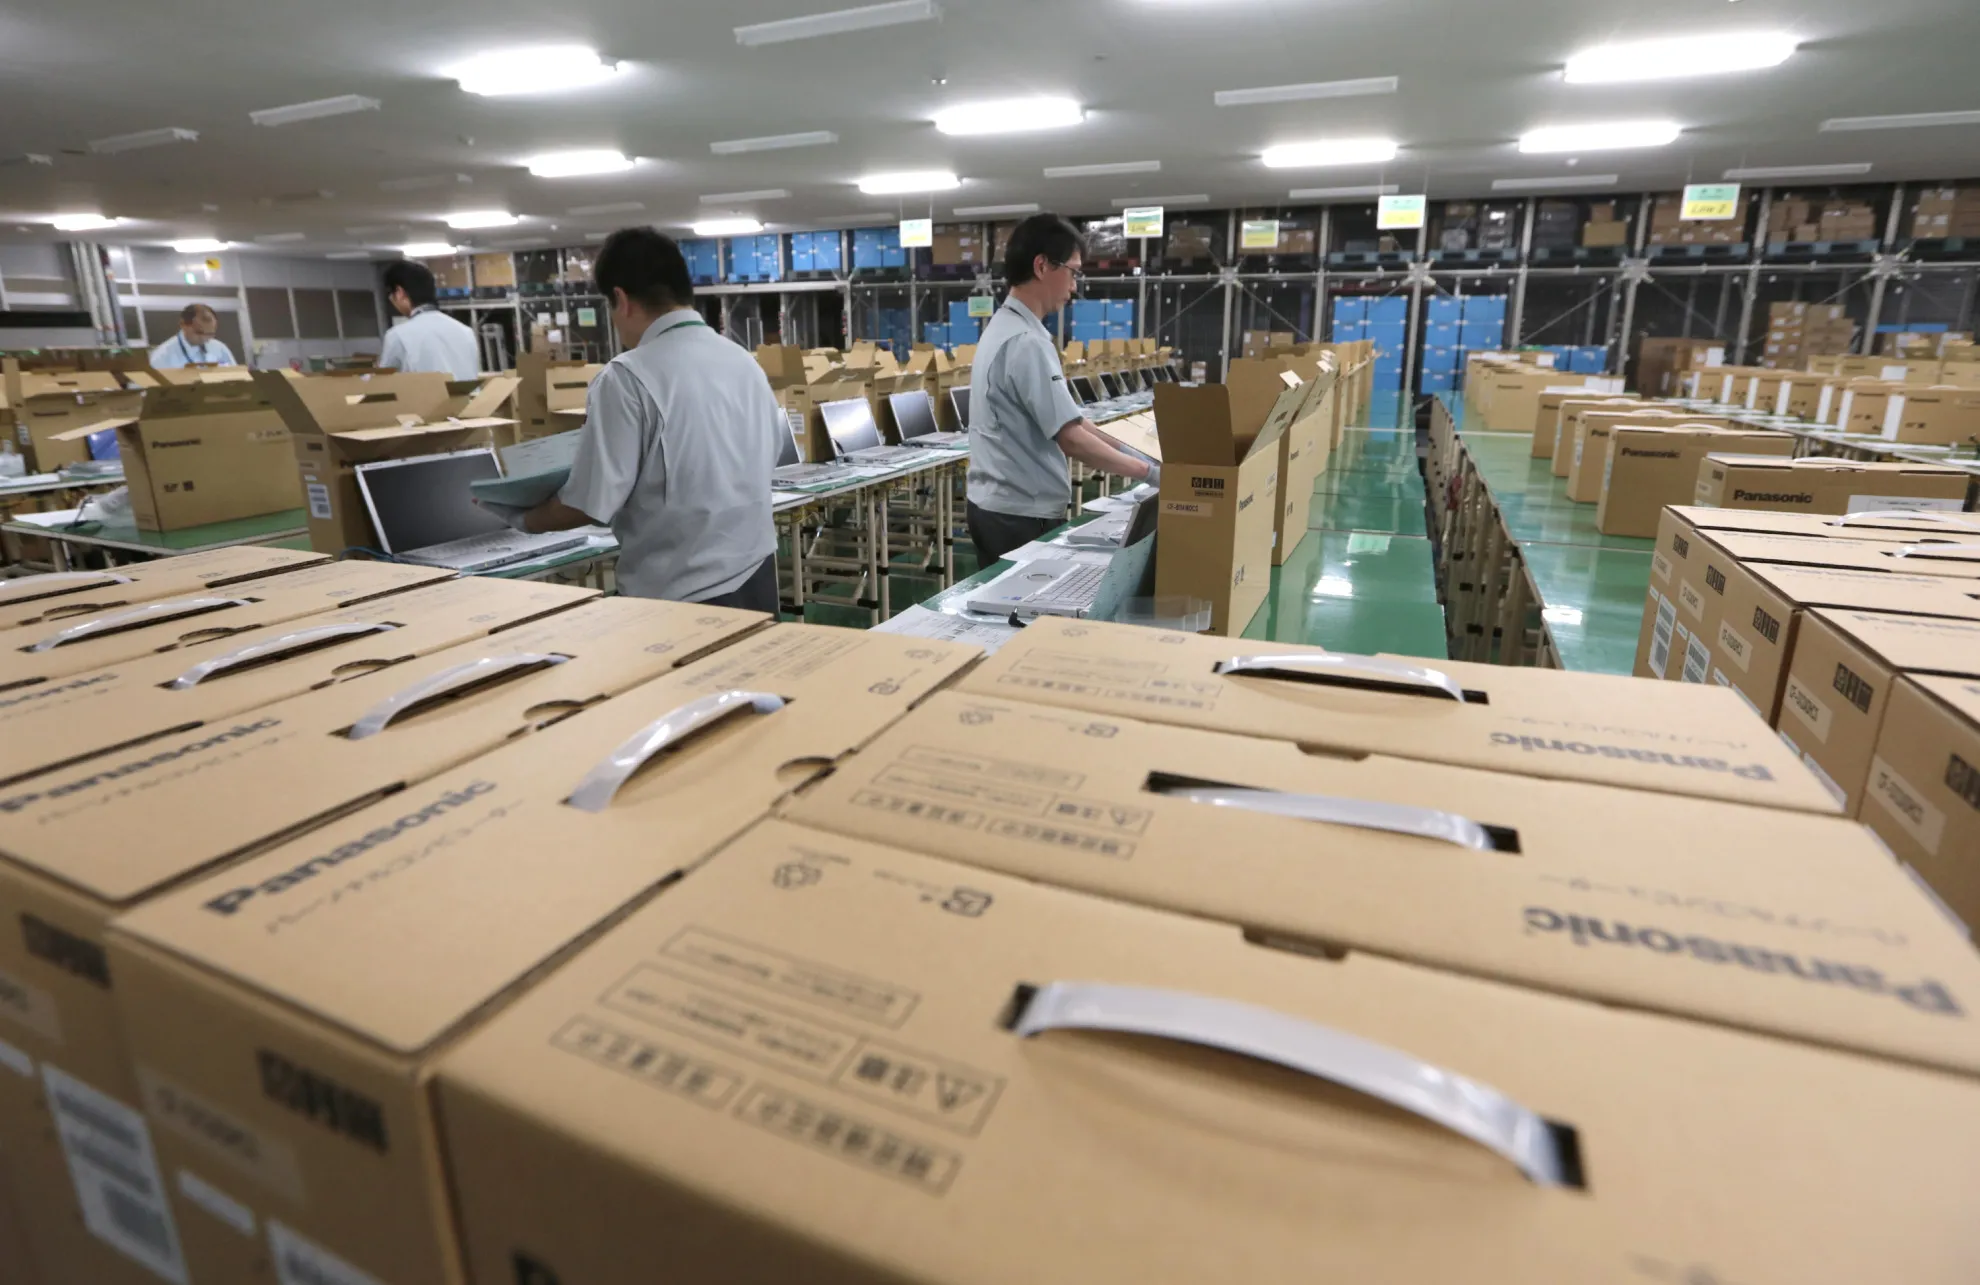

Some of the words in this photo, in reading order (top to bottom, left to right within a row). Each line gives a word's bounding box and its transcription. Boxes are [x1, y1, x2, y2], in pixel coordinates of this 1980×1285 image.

[1622, 447, 1681, 459] Panasonic
[1733, 488, 1813, 504] Panasonic
[1489, 730, 1777, 783] Panasonic
[204, 778, 498, 915] Panasonic
[1523, 906, 1966, 1018] Panasonic
